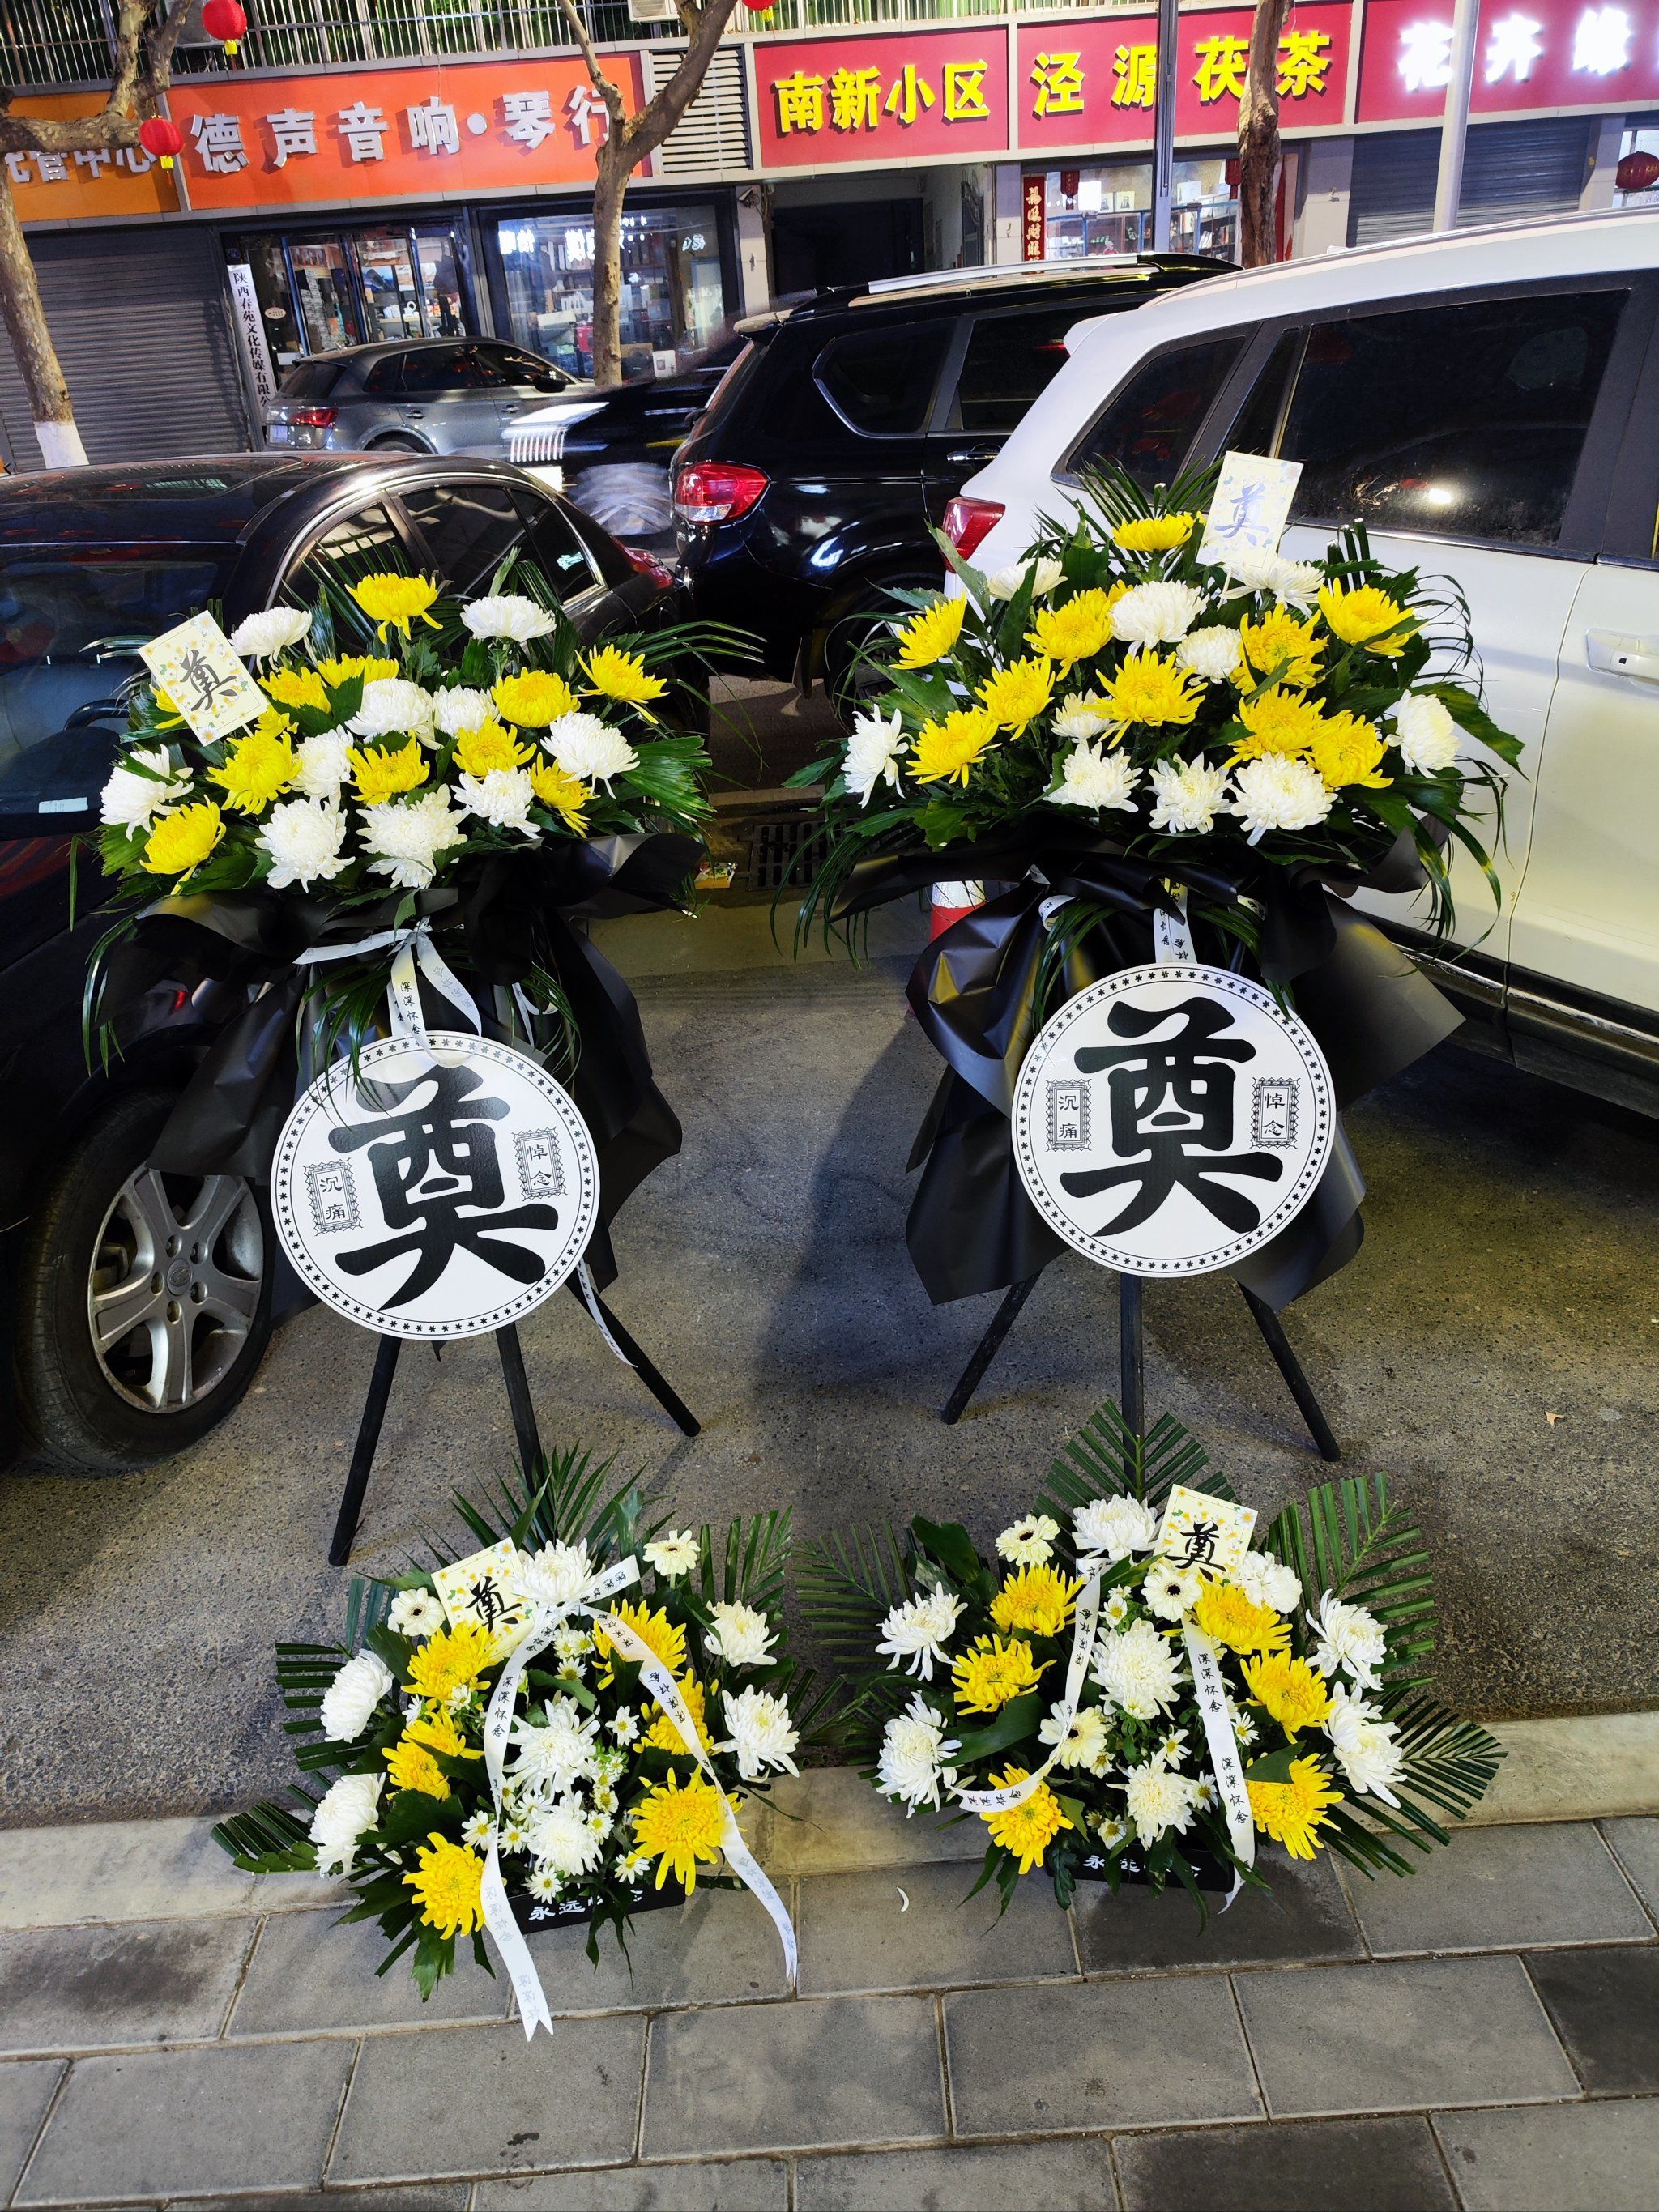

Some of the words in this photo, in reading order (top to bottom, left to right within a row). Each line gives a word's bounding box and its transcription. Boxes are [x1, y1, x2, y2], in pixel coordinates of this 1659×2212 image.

[774, 58, 991, 134] 南新小区
[1030, 30, 1331, 116] 泾源茯茶
[1026, 185, 1042, 261] 福旺财旺
[1214, 482, 1270, 546] 奠
[179, 649, 237, 712] 奠
[400, 981, 422, 1035] 深深怀念
[1058, 1095, 1079, 1139] 沉痛
[1060, 996, 1283, 1237] 奠
[1264, 1093, 1286, 1136] 悼念
[327, 1064, 559, 1311] 奠
[527, 1144, 551, 1187] 悼念
[319, 1178, 347, 1221] 沉痛
[1164, 1519, 1226, 1582] 奠
[465, 1575, 523, 1638] 奠
[491, 1676, 514, 1737] 深深怀念
[1198, 1653, 1223, 1713] 深深怀念
[1222, 1757, 1249, 1824] 深深怀念
